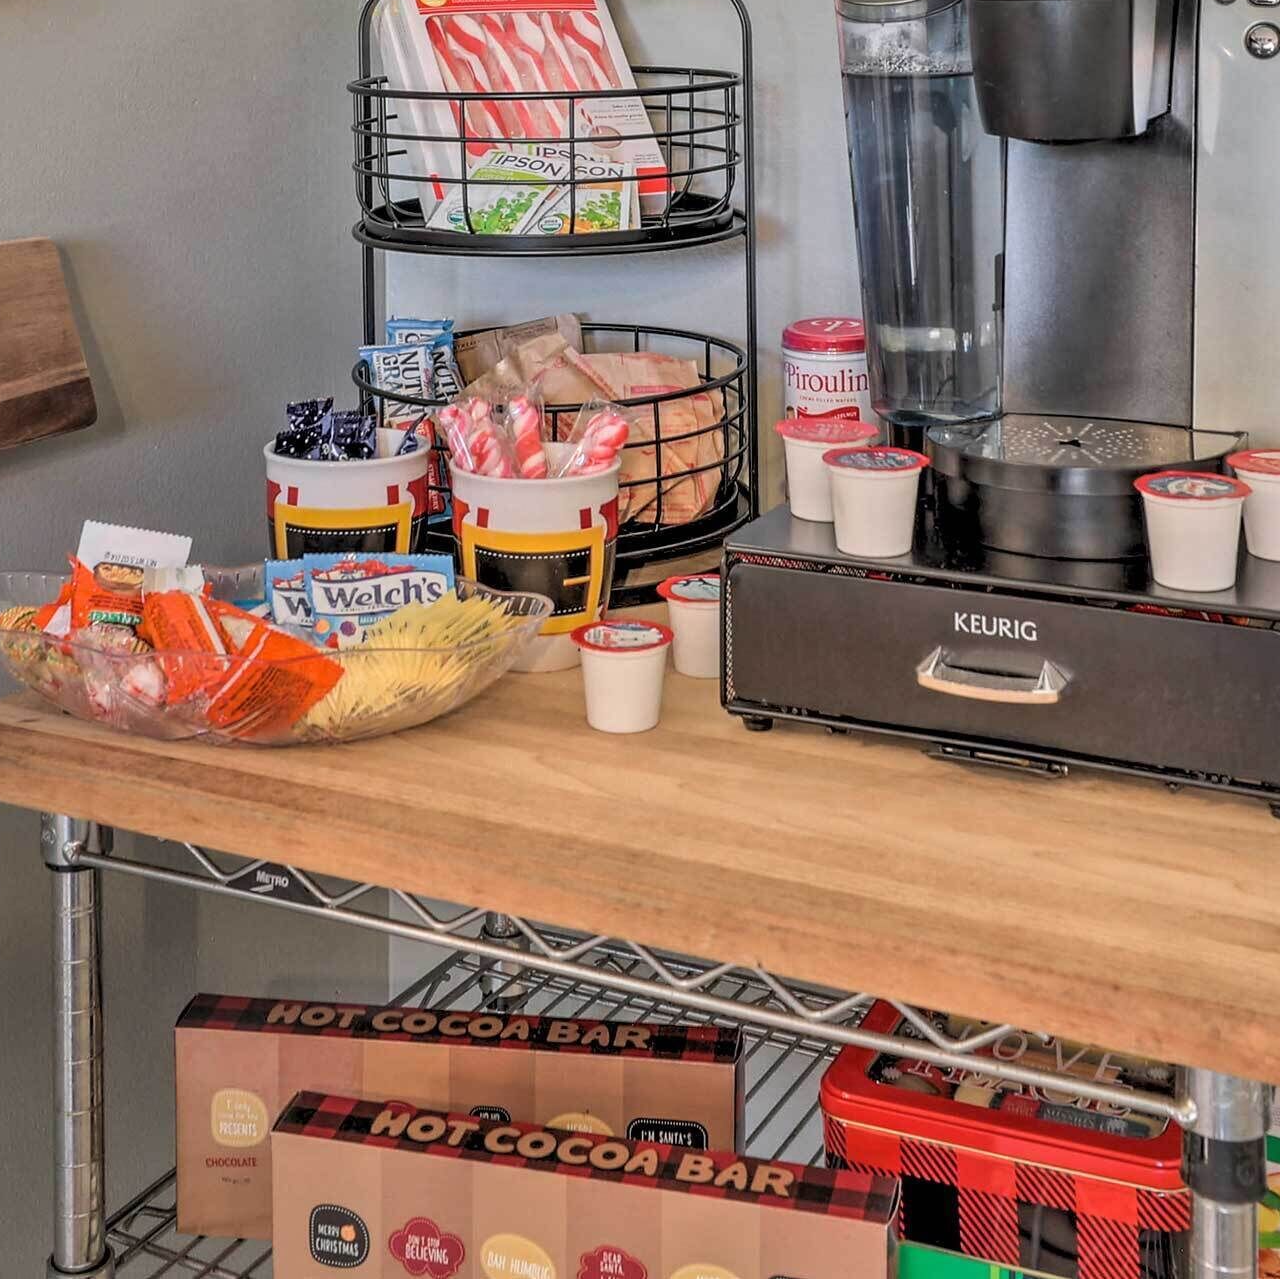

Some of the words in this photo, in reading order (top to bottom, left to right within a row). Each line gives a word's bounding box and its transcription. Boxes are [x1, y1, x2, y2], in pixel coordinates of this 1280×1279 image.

[784, 361, 869, 393] Piroulin
[321, 577, 443, 610] Welch's
[954, 612, 1038, 642] KEURIG
[268, 1003, 367, 1029] HOT
[370, 1010, 530, 1042] COCOA
[546, 1019, 652, 1049] BAR
[960, 1024, 1134, 1091] OVE
[370, 1109, 481, 1147] HOT
[484, 1126, 660, 1176] COCOA
[675, 1152, 795, 1197] BAR
[659, 1130, 692, 1147] SANTA'S
[205, 1157, 257, 1168] CHOCOLATE
[318, 1223, 340, 1238] MERRY
[315, 1237, 359, 1257] CHRISTMAS
[405, 1242, 449, 1265] BELIEVING
